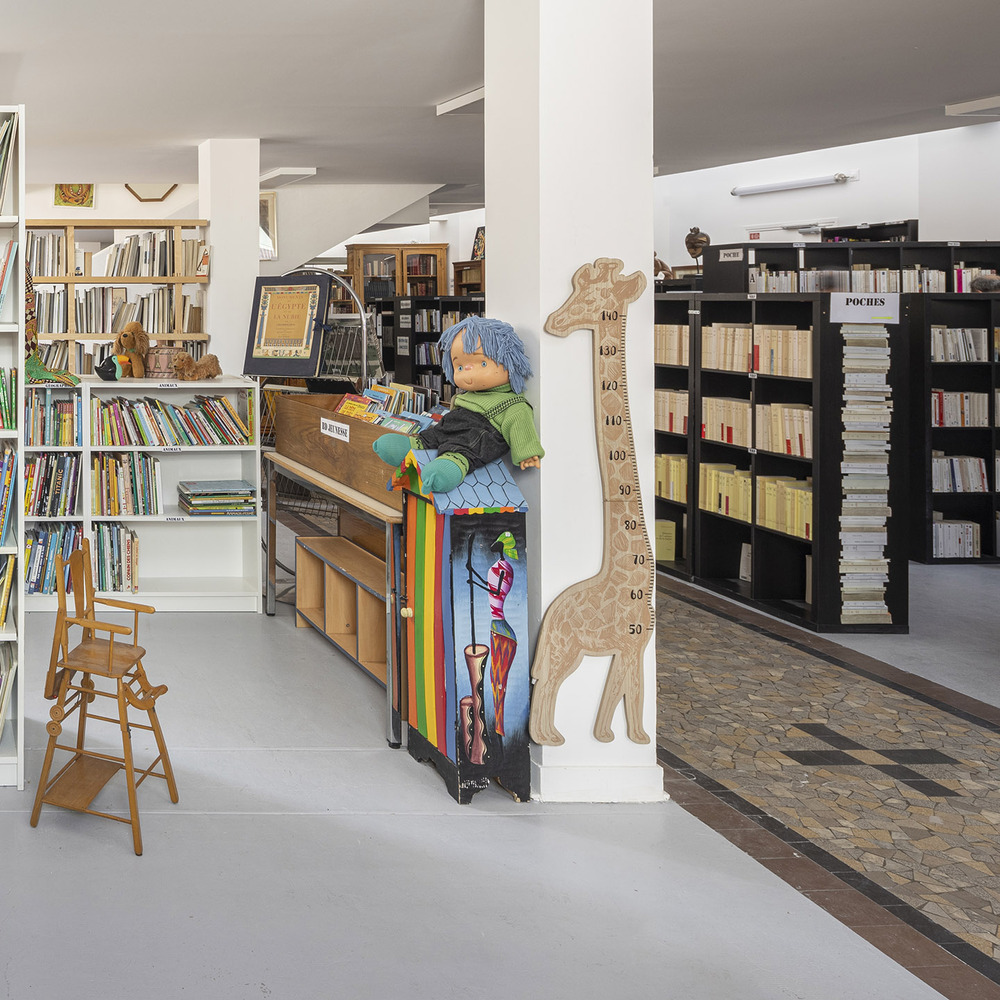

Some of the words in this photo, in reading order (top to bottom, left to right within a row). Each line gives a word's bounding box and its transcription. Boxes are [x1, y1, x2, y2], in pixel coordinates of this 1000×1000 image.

[750, 274, 755, 283] A
[845, 297, 885, 306] POCHES
[600, 310, 618, 321] 140
[599, 345, 617, 356] 130
[601, 380, 618, 391] 120
[605, 415, 622, 426] 110
[322, 422, 328, 430] BD
[328, 423, 348, 438] JEUNESSE
[609, 450, 626, 461] 100
[54, 469, 64, 495] TITANIC
[619, 485, 631, 495] 90
[624, 520, 636, 530] 80
[633, 555, 645, 565] 70
[630, 589, 643, 600] 60
[629, 624, 642, 635] 50
